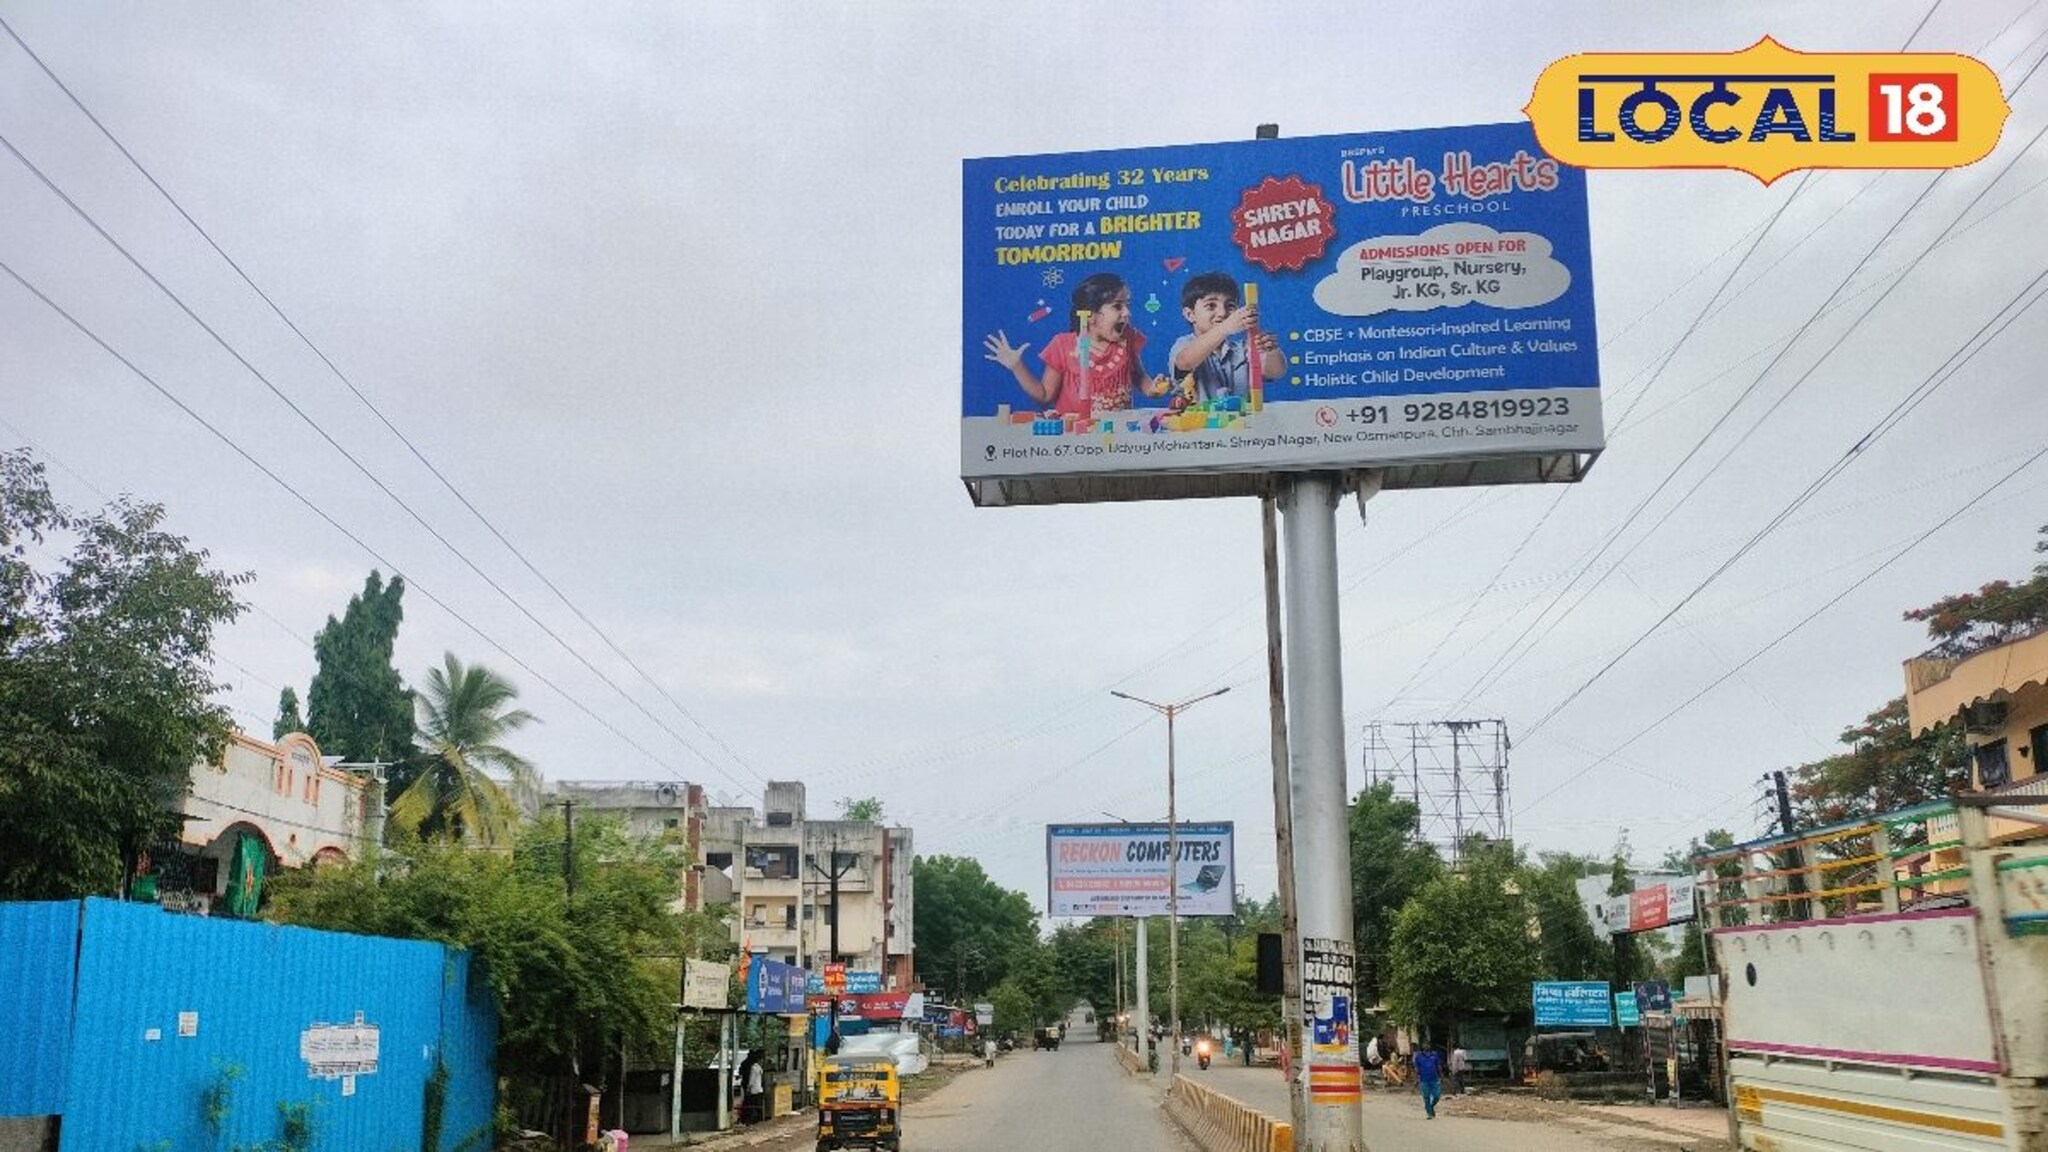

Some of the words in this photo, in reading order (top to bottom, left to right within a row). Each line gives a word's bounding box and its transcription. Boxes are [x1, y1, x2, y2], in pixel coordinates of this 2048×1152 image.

[995, 171, 1110, 193] Celebrating
[1118, 169, 1144, 185] 32
[1152, 167, 1209, 183] Years
[1342, 157, 1435, 203] Little
[1443, 150, 1558, 197] Hearts
[996, 201, 1053, 217] ENROLL
[1058, 197, 1101, 212] YOUR
[1106, 195, 1149, 210] CHILD
[1244, 198, 1321, 228] SHREYA
[1402, 201, 1510, 217] PRESCHOOL
[996, 225, 1045, 240] TODAY
[1050, 223, 1079, 237] FOR
[1084, 223, 1095, 235] A
[1101, 211, 1200, 234] BRIGHTER
[1250, 218, 1322, 248] NAGAR
[996, 241, 1122, 265] TOMORROW
[1360, 241, 1449, 260] ADMISSIONS
[1455, 242, 1493, 255] OPEN
[1498, 240, 1526, 252] FOR
[1361, 266, 1449, 282] Playgroup,
[1454, 261, 1526, 277] Nursery,
[1393, 284, 1412, 299] Jr.
[1417, 282, 1445, 299] KG,
[1451, 282, 1471, 295] Sr.
[1477, 279, 1501, 293] KG
[1304, 329, 1343, 342] CBSE
[1359, 320, 1499, 340] Montessori-Inspired
[1505, 317, 1571, 333] Learning
[1305, 350, 1372, 365] Emphasis
[1377, 350, 1395, 361] on
[1399, 346, 1446, 359] Indian
[1451, 342, 1506, 357] Culture
[1511, 341, 1523, 353] &
[1528, 340, 1577, 352] Values
[1305, 373, 1357, 387] Holistic
[1361, 370, 1398, 383] Child
[1404, 365, 1505, 382] Development
[1346, 405, 1388, 424] +91
[1404, 397, 1569, 422] 9284819923
[1003, 448, 1027, 458] Plot
[1230, 436, 1275, 450] Shreya
[1278, 435, 1319, 447] Nagar,
[1324, 433, 1352, 443] New
[1059, 841, 1121, 863] RECKON
[1305, 962, 1352, 985] BINGO
